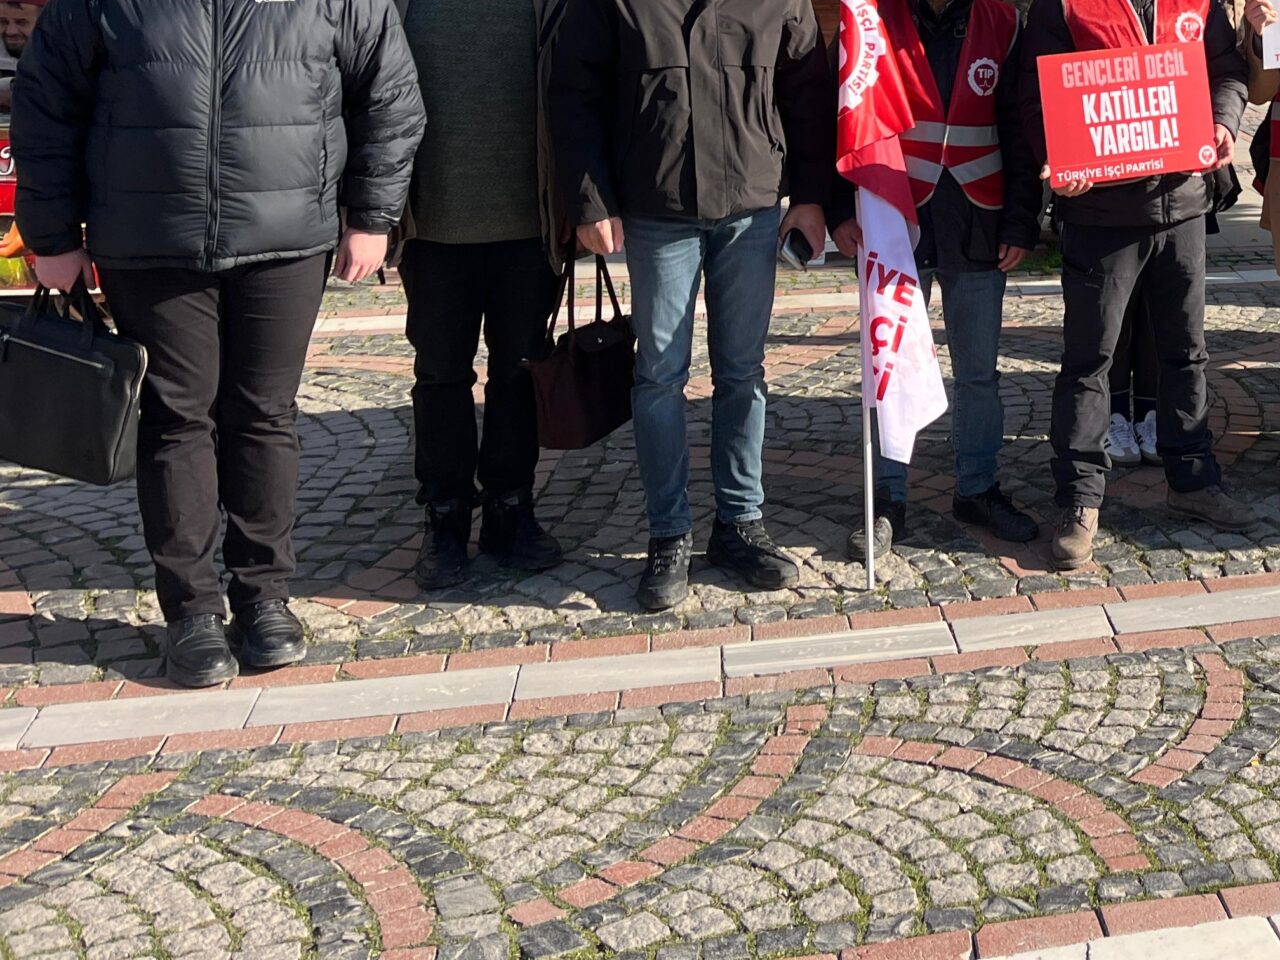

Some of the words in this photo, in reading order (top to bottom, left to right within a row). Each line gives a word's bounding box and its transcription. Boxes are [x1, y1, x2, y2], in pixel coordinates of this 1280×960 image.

[848, 42, 876, 96] PARTİSİ
[1062, 52, 1140, 88] GENÇLERİ
[1144, 48, 1188, 79] DEĞİL
[1082, 81, 1178, 125] KATİLLERİ
[1089, 117, 1180, 157] YARGILA!
[1056, 167, 1102, 182] TÜRKİYE
[1104, 164, 1125, 178] İŞÇİ
[1126, 157, 1164, 173] PARTİSİ
